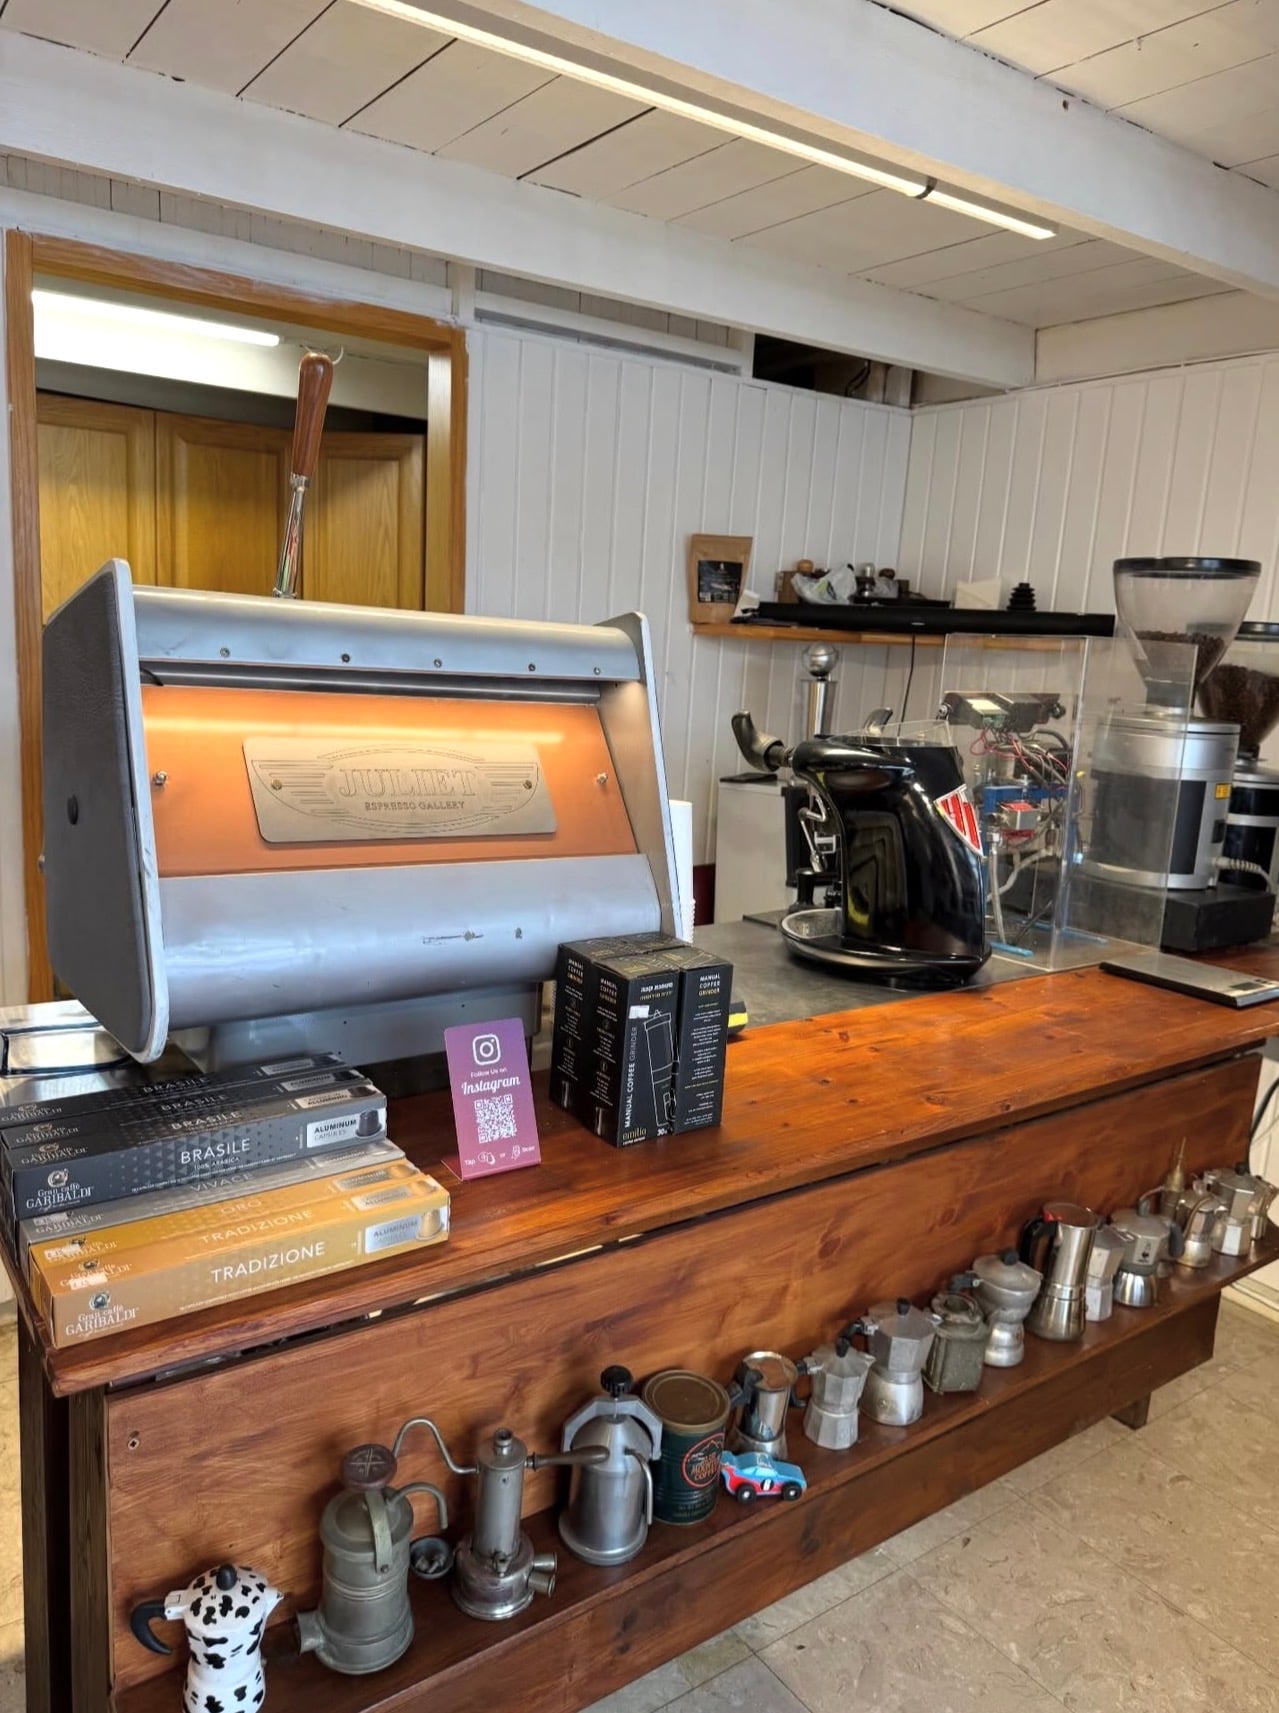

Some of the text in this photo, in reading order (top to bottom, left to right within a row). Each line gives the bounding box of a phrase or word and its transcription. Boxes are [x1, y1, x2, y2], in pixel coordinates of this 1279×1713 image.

[339, 768, 476, 797] JULIET
[365, 800, 465, 811] ESPRESSO GALLERY
[699, 980, 720, 989] COFFEE
[700, 973, 720, 982] MANUAL
[699, 988, 720, 997] GRINDER
[143, 1077, 210, 1093] BRASILE
[461, 1076, 521, 1095] Instagram
[624, 1026, 638, 1128] MANUAL COFFEE GRINDER
[161, 1094, 229, 1111] BRASILE
[171, 1111, 242, 1130] BRASILE
[314, 1119, 357, 1134] ALUMINUM
[181, 1138, 250, 1164] BRASILE
[190, 1173, 254, 1192] VIVACE
[26, 1187, 92, 1209] GARIBALDI
[38, 1187, 58, 1198] Gran
[220, 1199, 262, 1215] ORO
[200, 1210, 313, 1244] TRADIZIONE
[373, 1220, 418, 1238] ALUMINUM
[210, 1241, 326, 1283] TRADIZIONE
[66, 1309, 137, 1336] GARIBALDI
[78, 1312, 100, 1323] Gran
